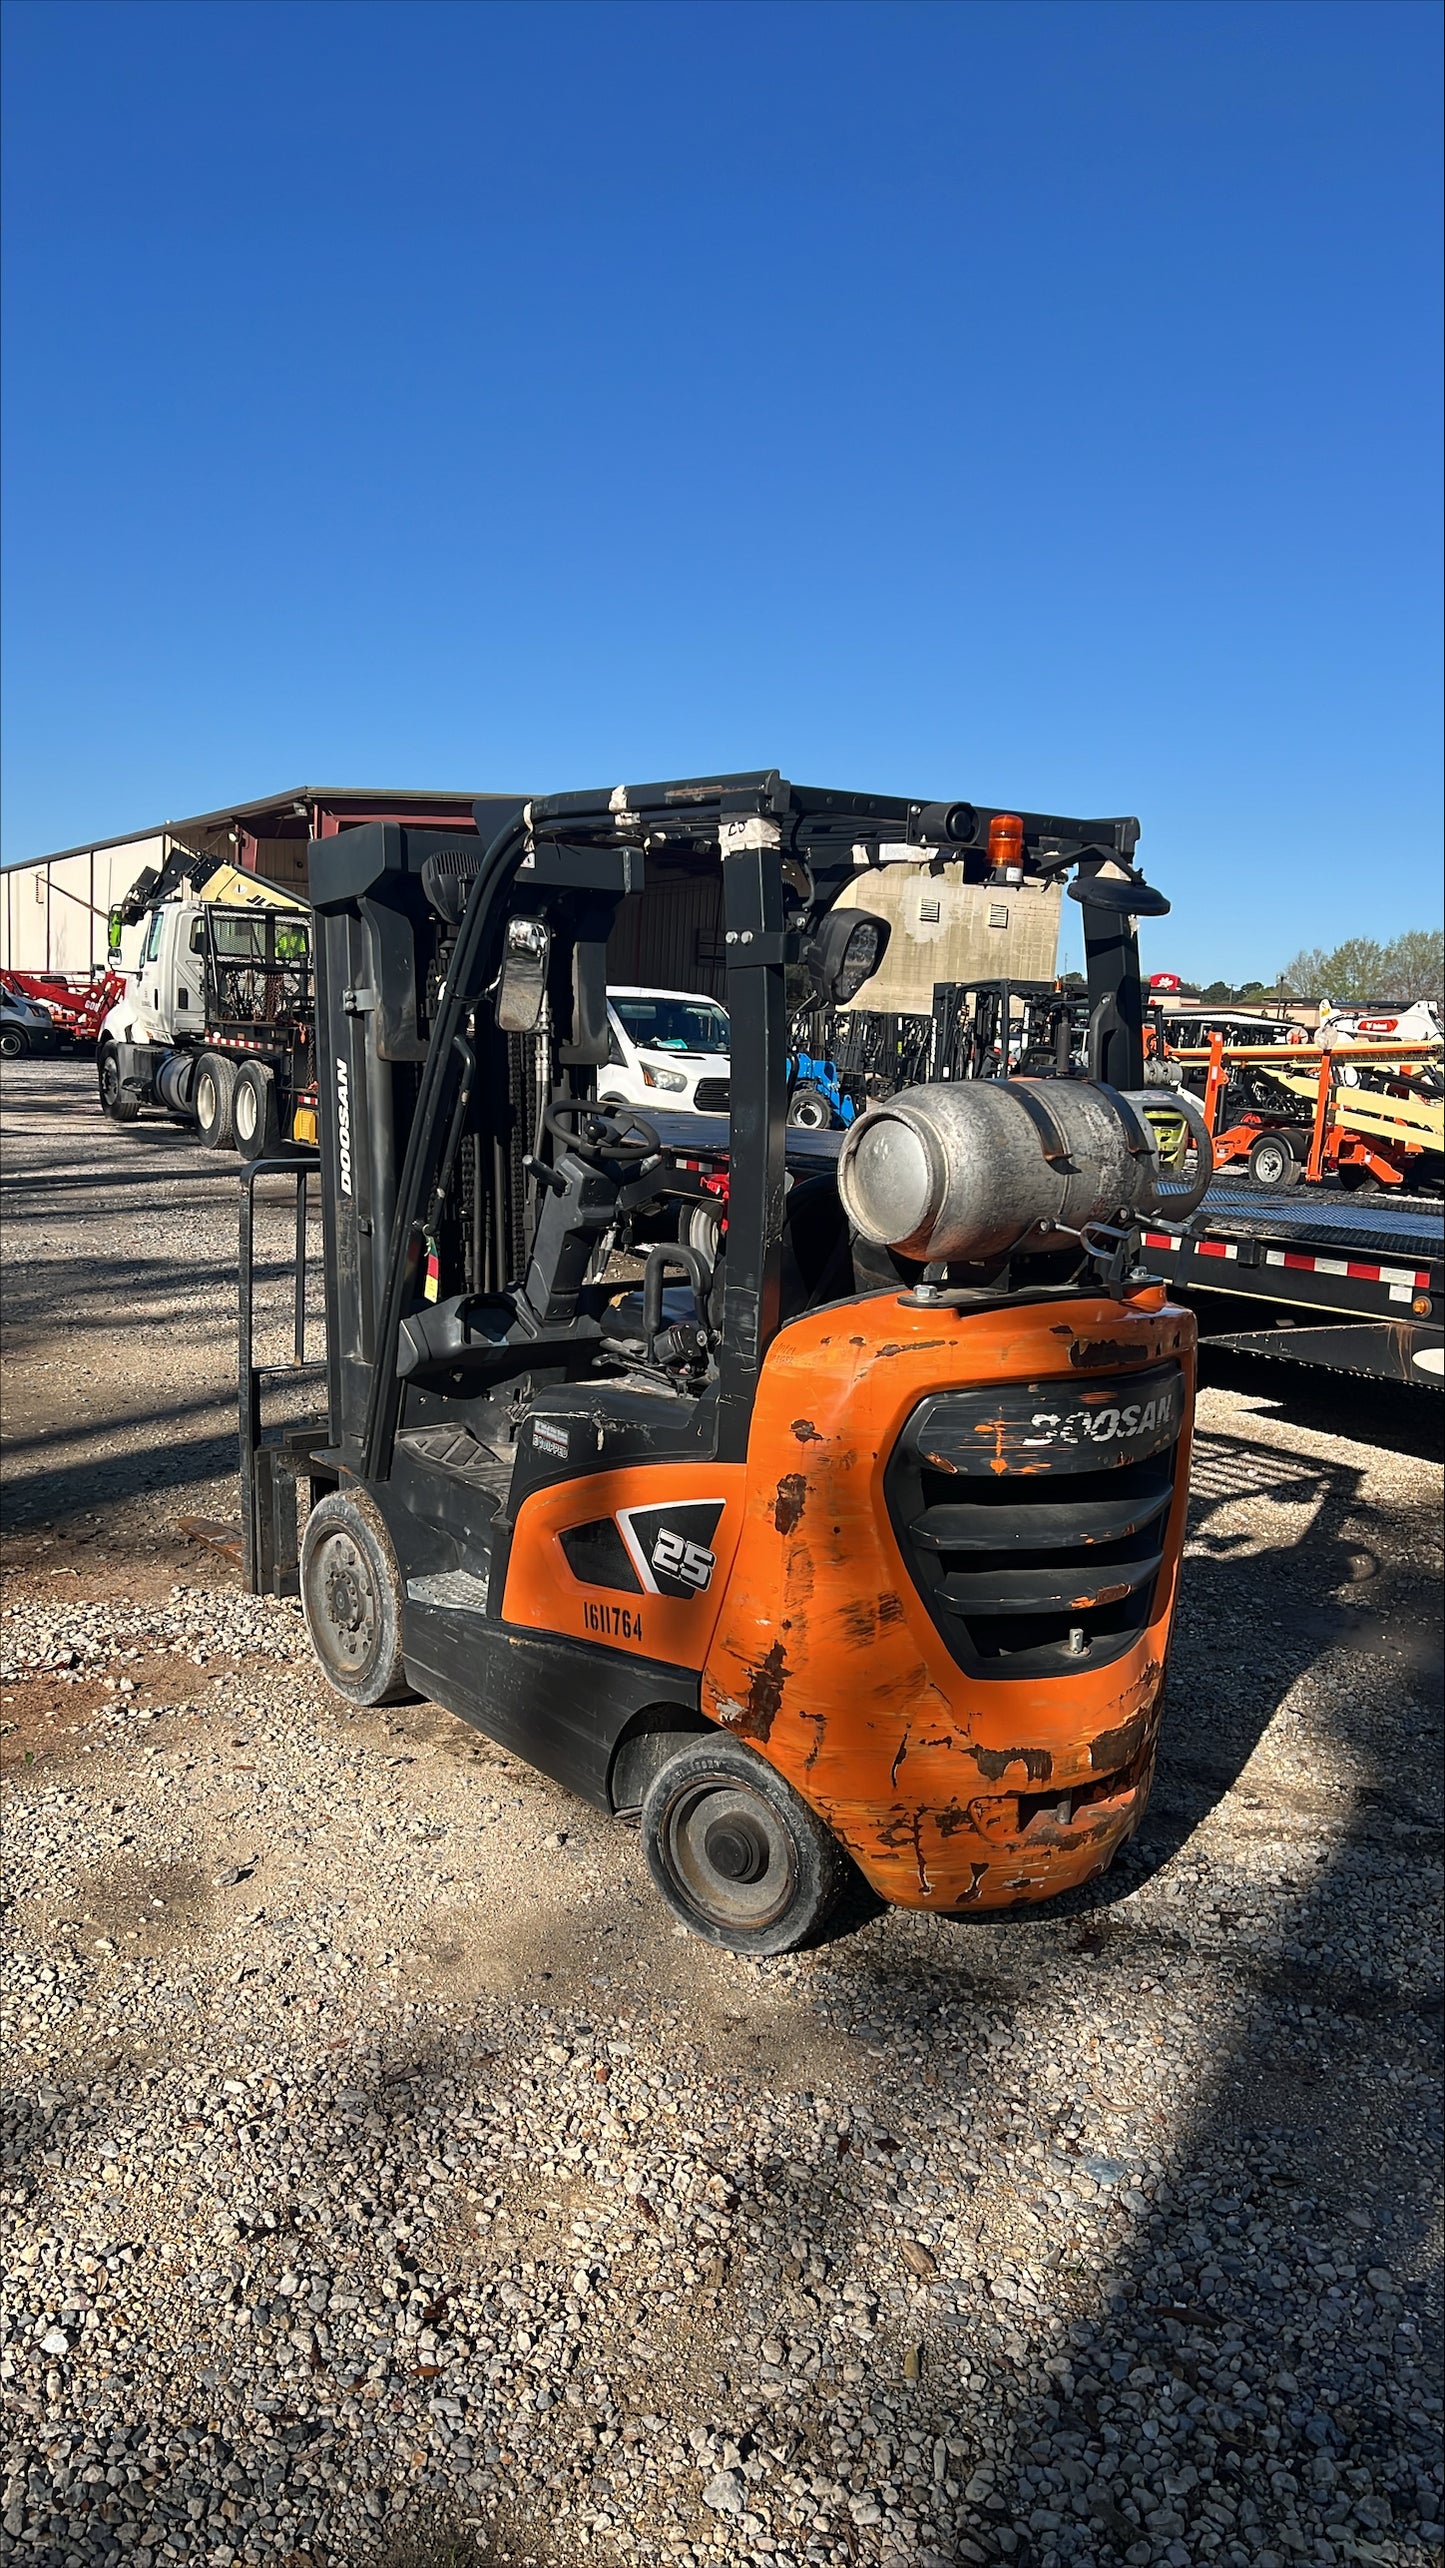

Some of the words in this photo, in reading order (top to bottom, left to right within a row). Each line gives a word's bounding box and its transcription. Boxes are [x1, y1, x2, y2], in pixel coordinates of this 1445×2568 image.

[336, 1057, 352, 1196] DOOSAN
[652, 1528, 716, 1592] 25
[583, 1601, 642, 1642] 1611764
